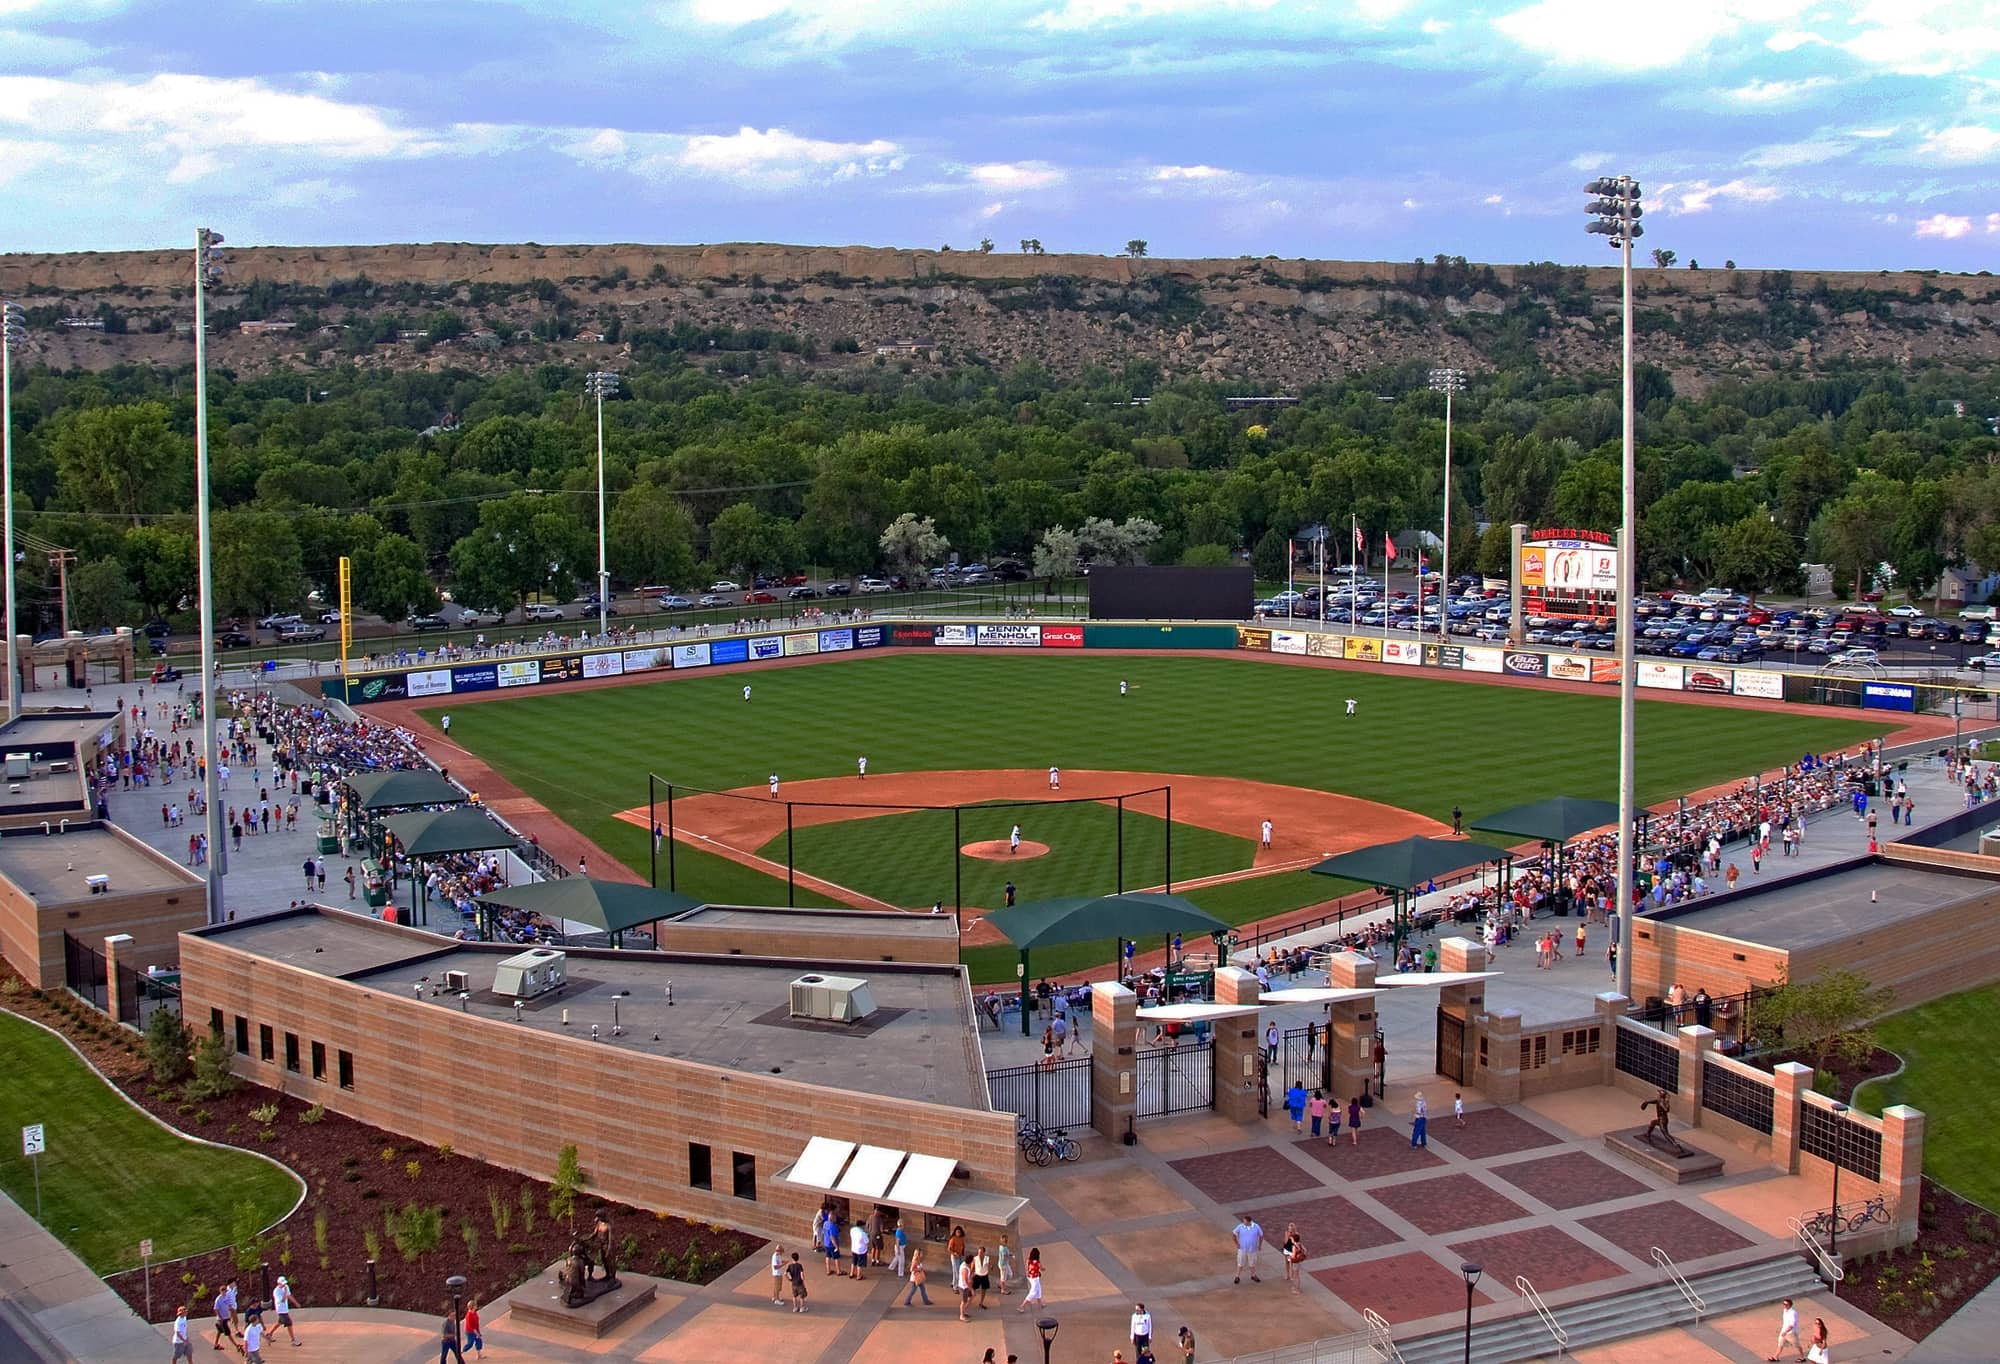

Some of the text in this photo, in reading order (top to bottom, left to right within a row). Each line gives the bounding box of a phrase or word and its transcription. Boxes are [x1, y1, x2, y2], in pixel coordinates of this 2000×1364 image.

[1532, 529, 1610, 543] DEHLER PARK
[1043, 632, 1083, 642] Great Clips
[1515, 654, 1541, 663] BUD
[1511, 662, 1544, 670] LIGHT
